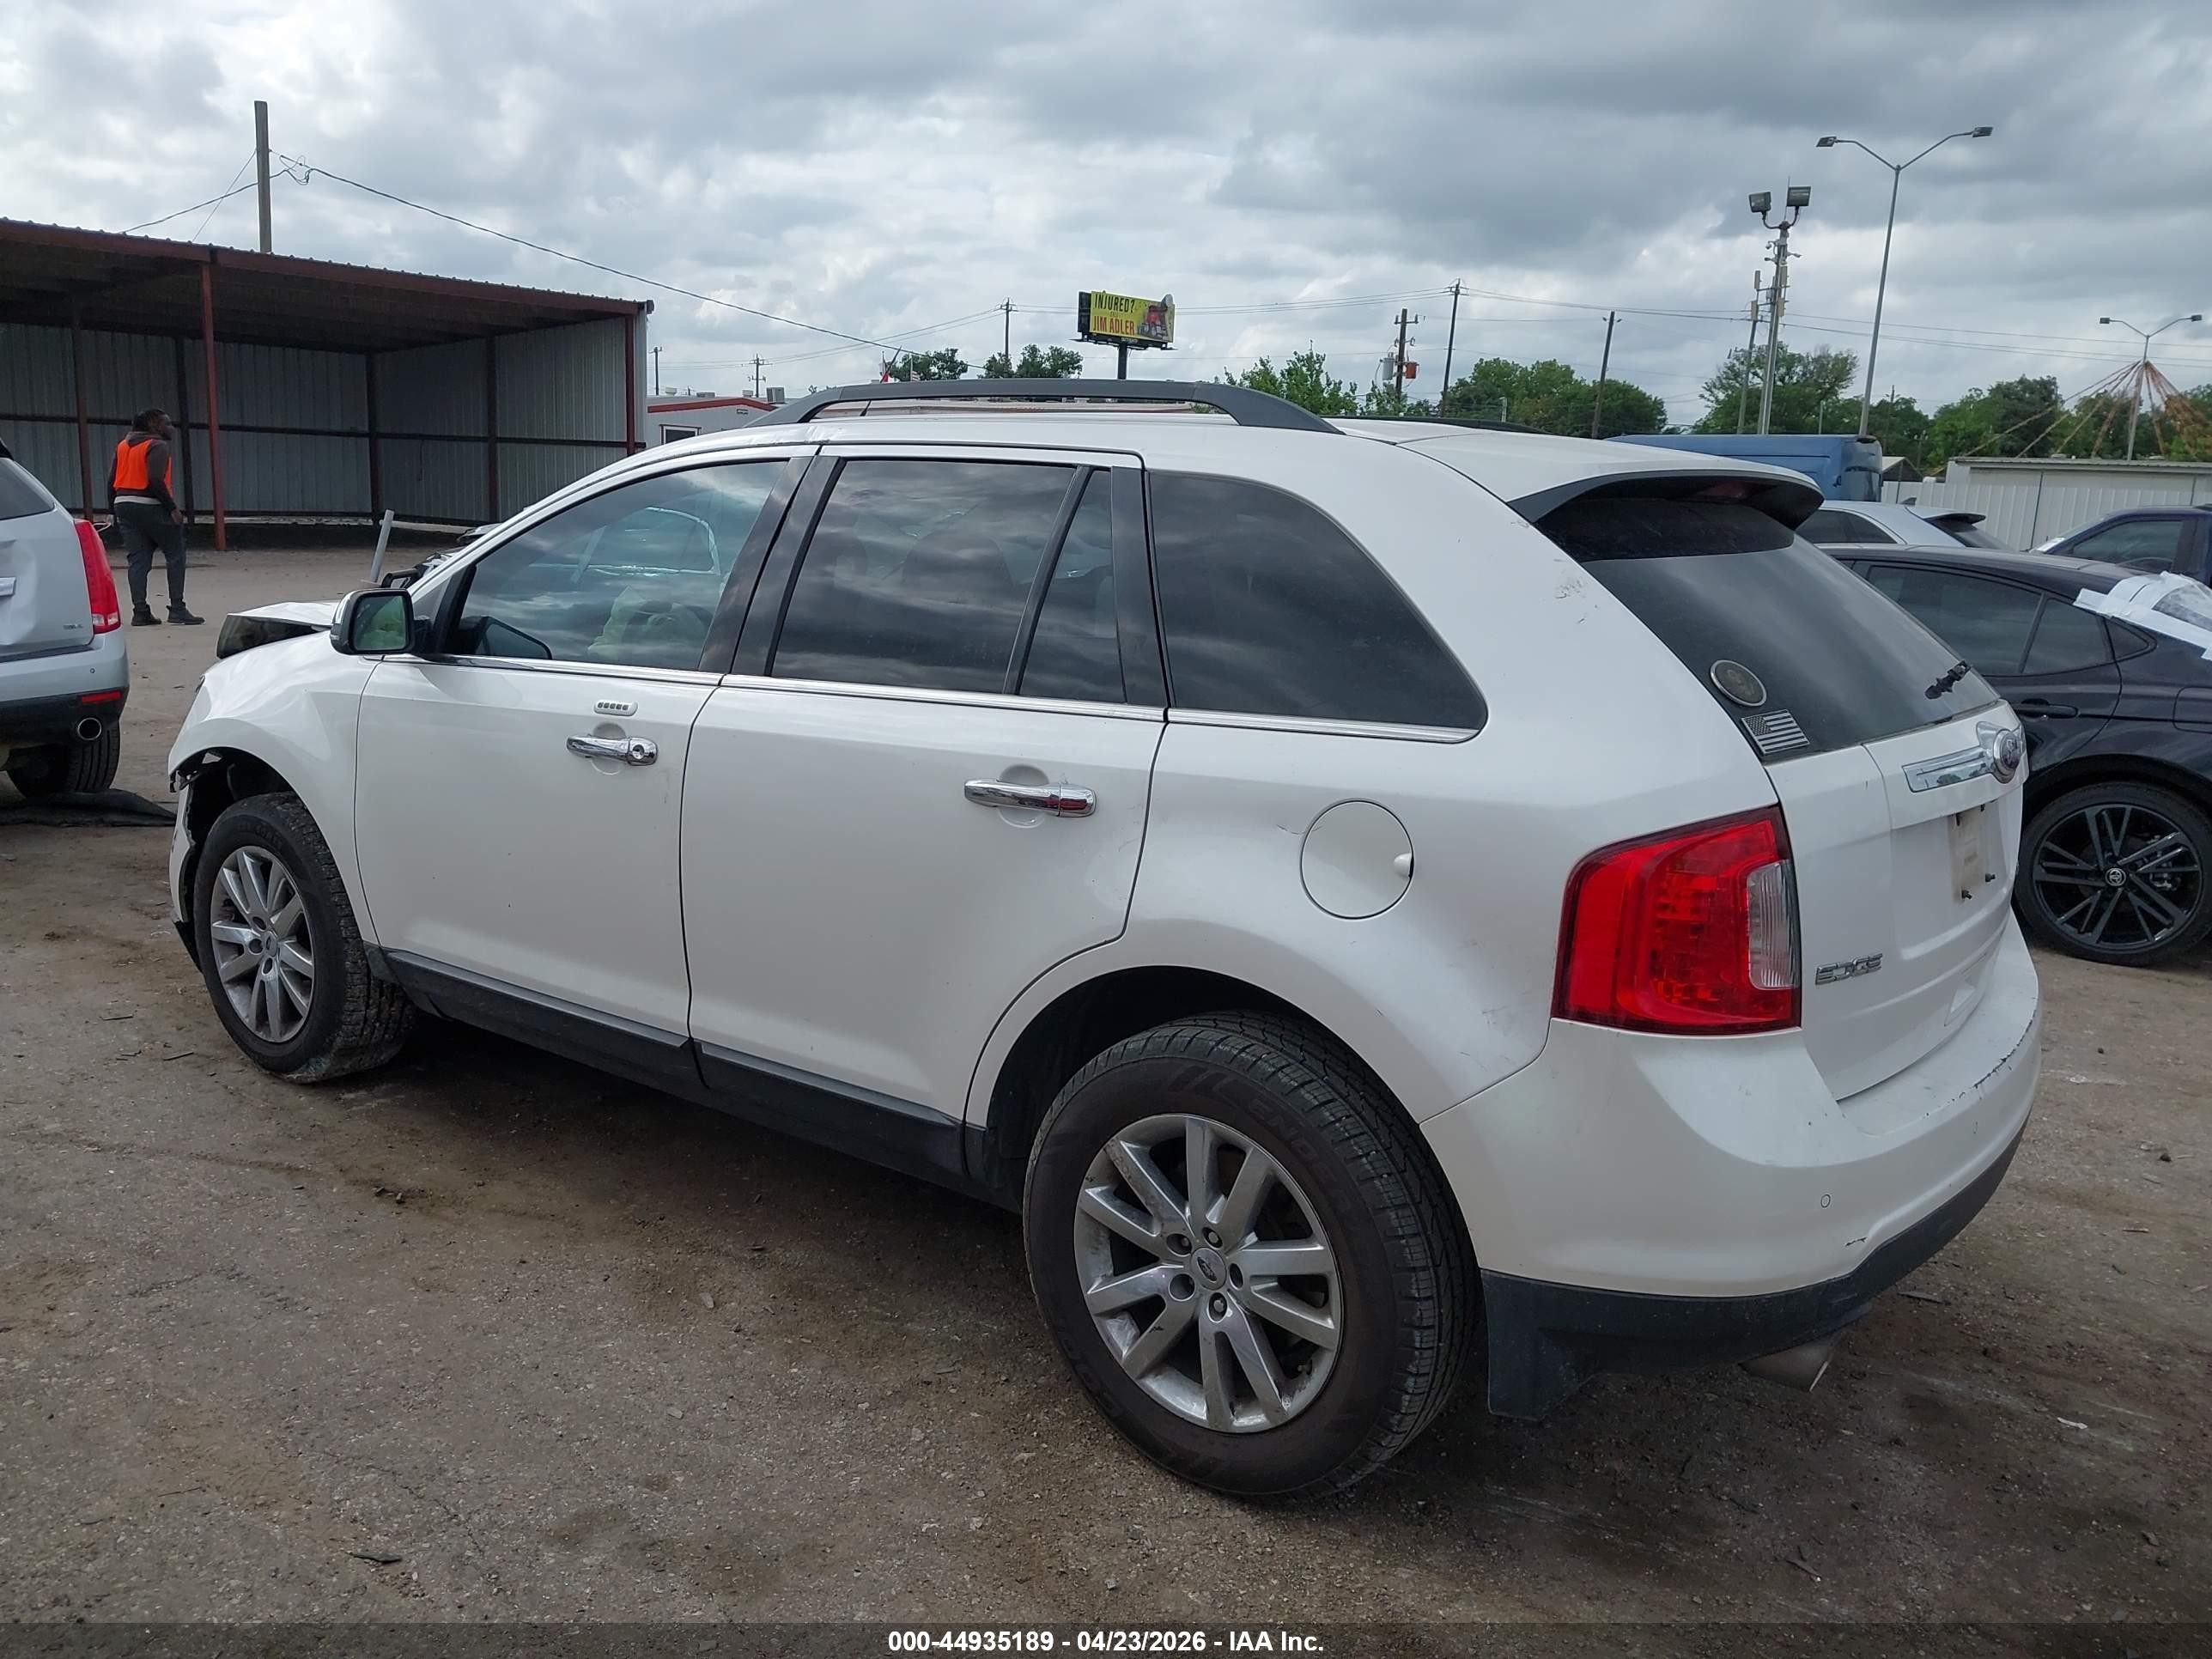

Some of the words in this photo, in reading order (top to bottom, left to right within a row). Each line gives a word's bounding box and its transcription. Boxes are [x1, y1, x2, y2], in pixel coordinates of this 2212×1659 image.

[1094, 294, 1135, 313] INJURED?
[1093, 315, 1108, 331] JIM
[1109, 318, 1134, 335] ADLER
[1814, 953, 1883, 986] EDGE
